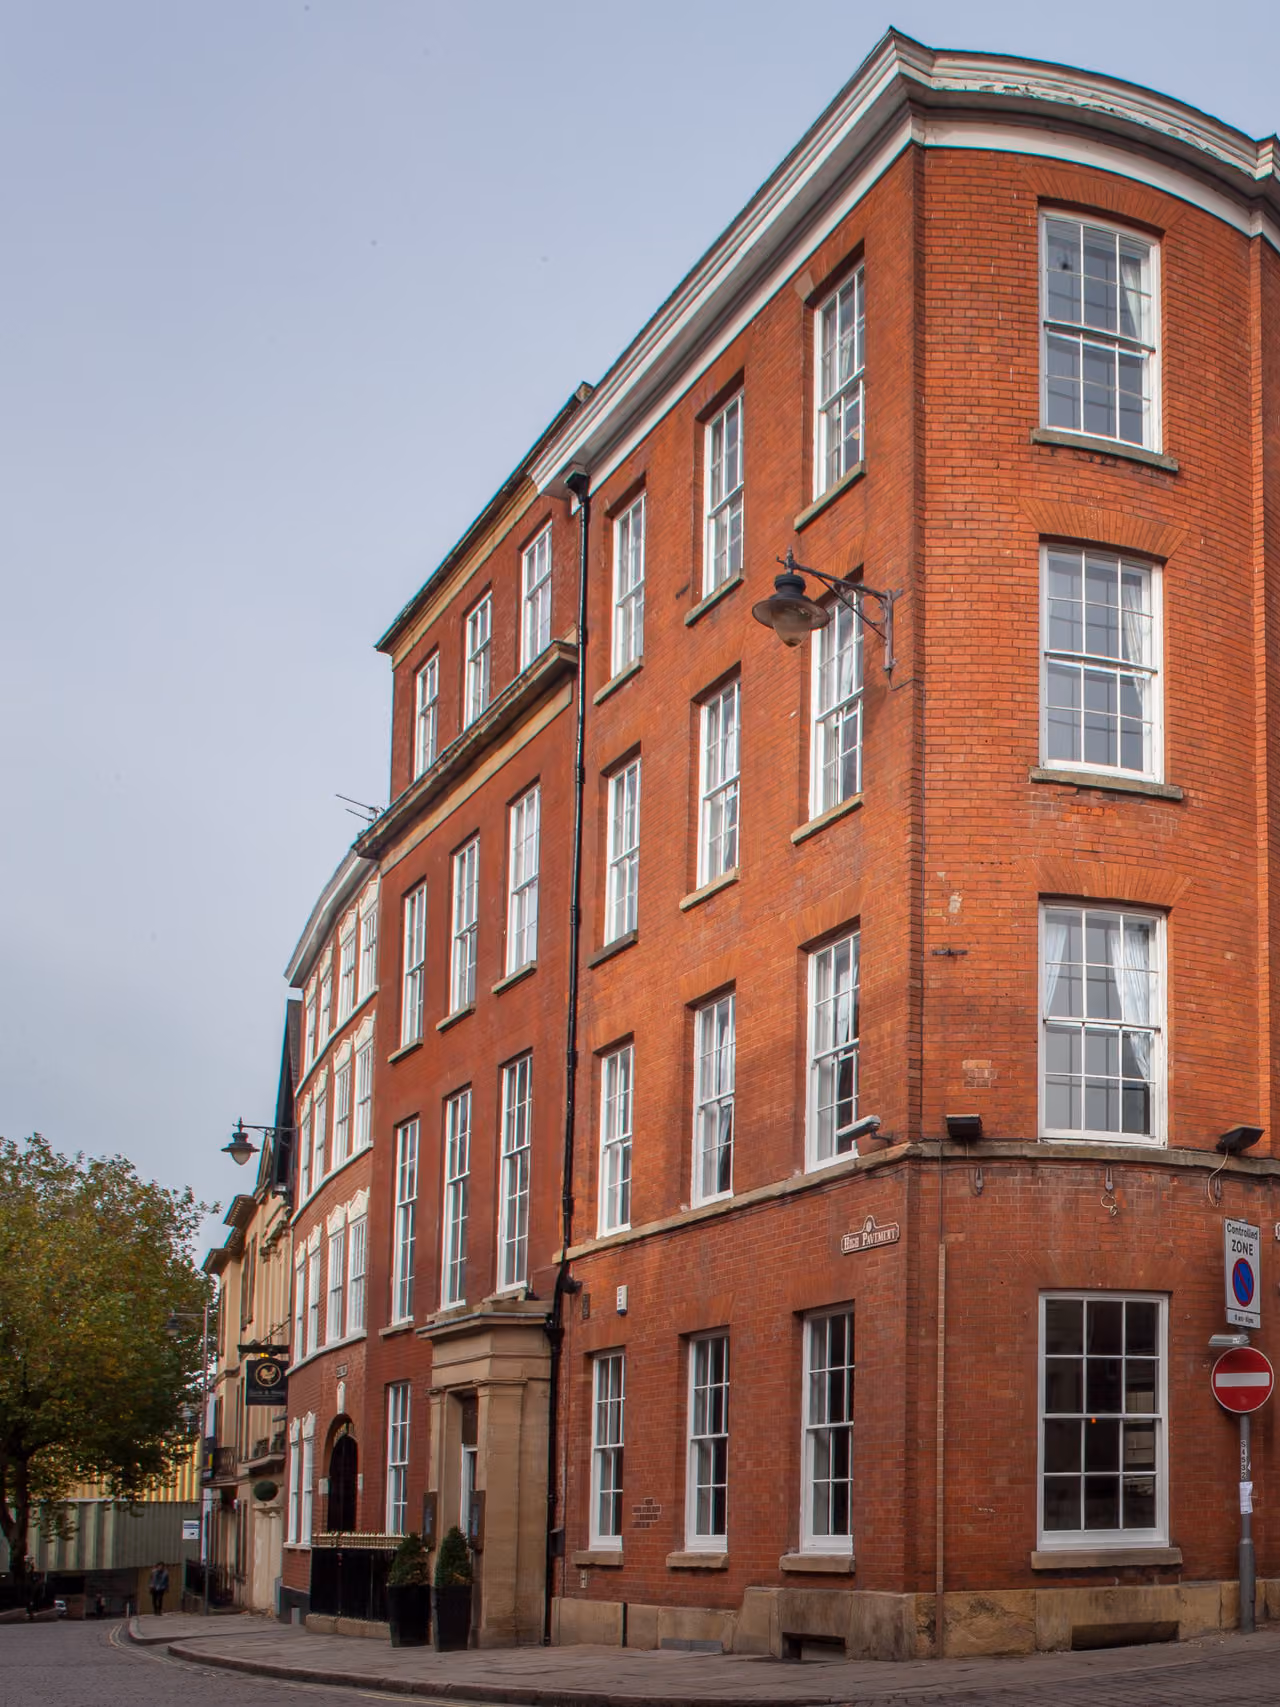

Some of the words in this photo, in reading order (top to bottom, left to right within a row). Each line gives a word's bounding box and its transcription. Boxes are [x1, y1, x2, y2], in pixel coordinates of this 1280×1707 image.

[862, 1229, 896, 1246] PAVEMENT
[1226, 1223, 1258, 1240] Controlled
[1231, 1239, 1254, 1256] ZONE
